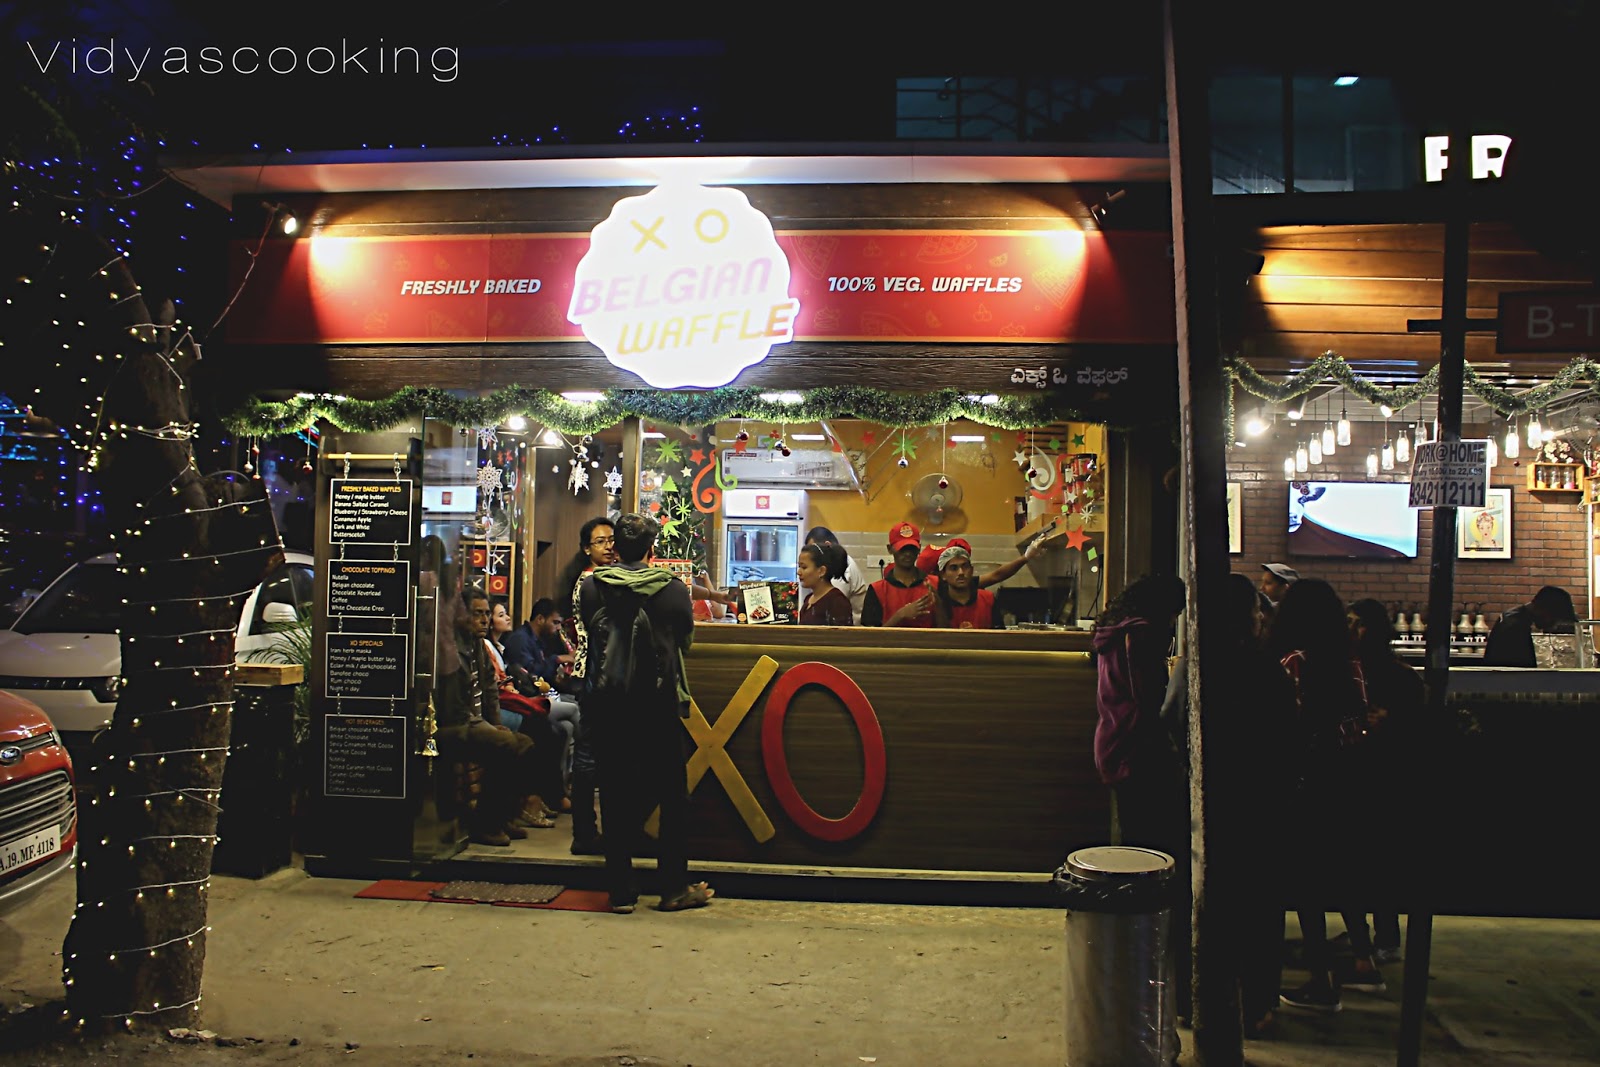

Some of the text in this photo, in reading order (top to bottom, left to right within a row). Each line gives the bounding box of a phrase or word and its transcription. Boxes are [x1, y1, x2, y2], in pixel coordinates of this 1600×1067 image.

[401, 279, 542, 295] FRESHLY BAKED
[574, 257, 773, 316] BELGIAN
[828, 277, 1022, 293] 100% VEG. WAFFLES
[617, 302, 794, 355] WAFFLE
